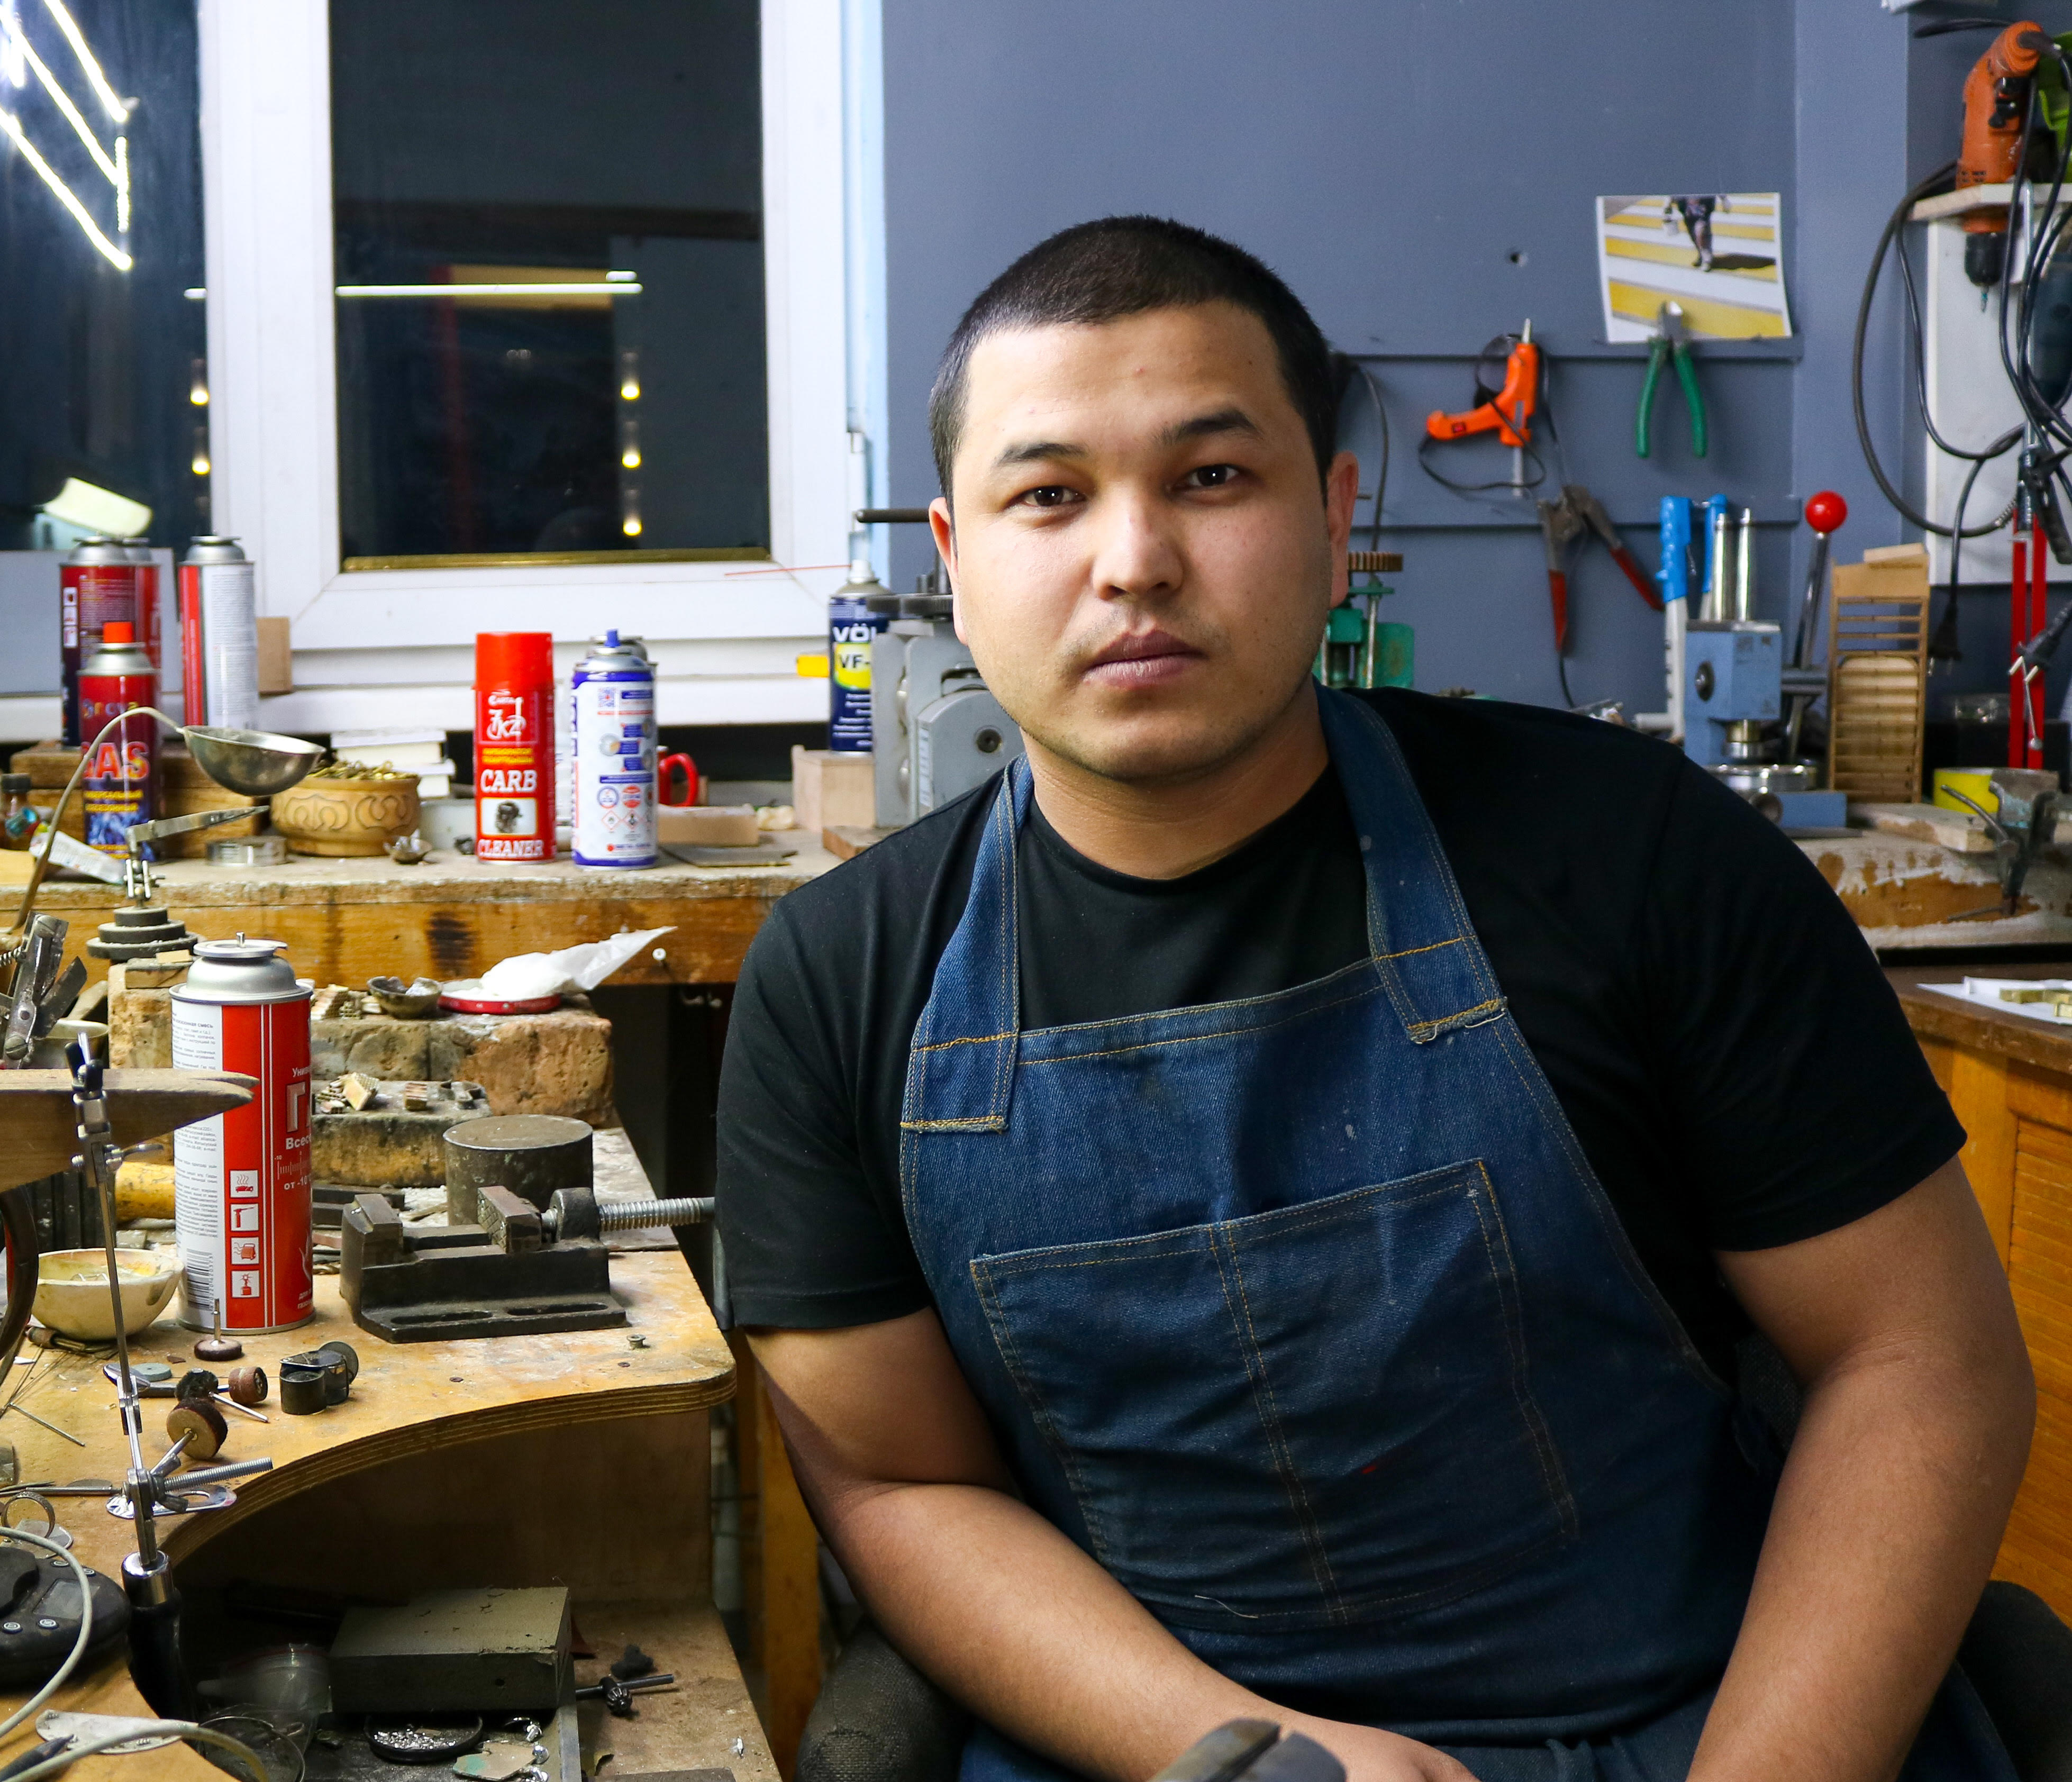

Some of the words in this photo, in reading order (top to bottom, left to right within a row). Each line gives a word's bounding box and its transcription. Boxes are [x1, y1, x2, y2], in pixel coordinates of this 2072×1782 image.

[480, 769, 538, 793] CARB
[477, 839, 544, 858] CLEANER
[286, 1081, 311, 1132] Г
[284, 1181, 295, 1190] от
